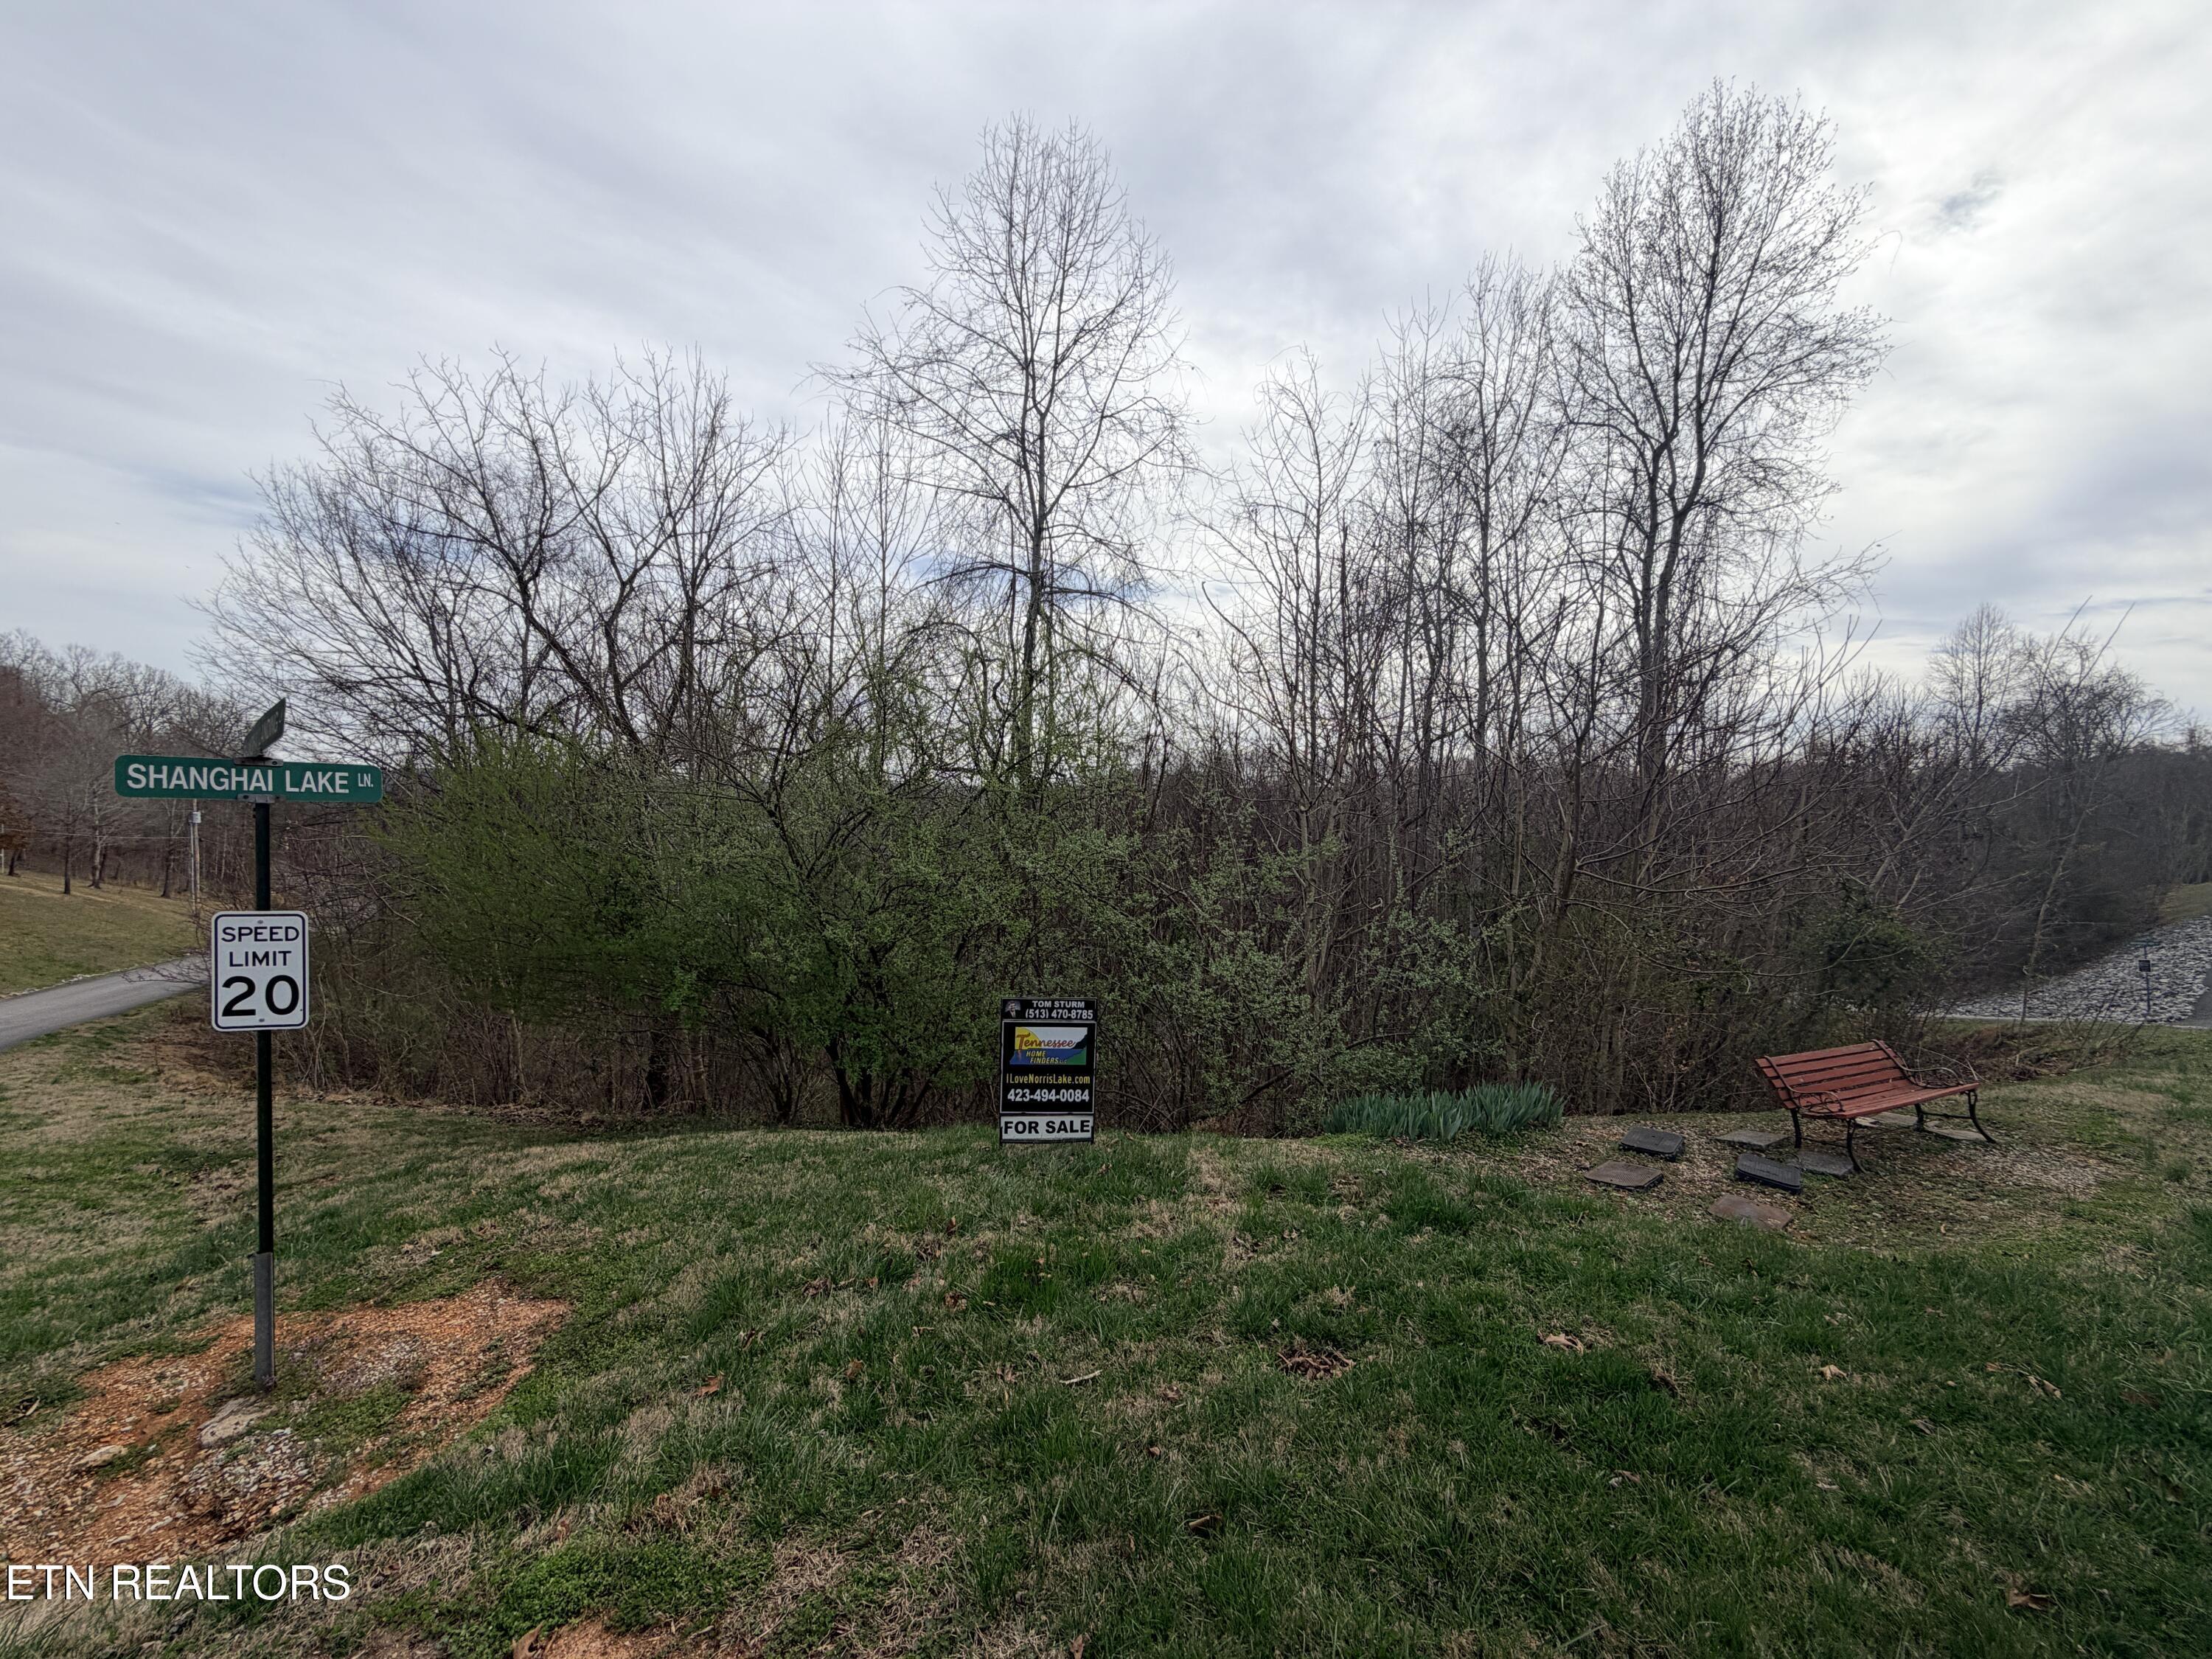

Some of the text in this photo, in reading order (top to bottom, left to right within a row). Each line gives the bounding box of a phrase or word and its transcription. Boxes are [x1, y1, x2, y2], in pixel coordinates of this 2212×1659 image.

[127, 763, 374, 793] SHANGHAI LAKE LN.
[221, 926, 299, 942] SPEED
[229, 950, 292, 967] LIMIT
[221, 975, 299, 1017] 20
[1032, 1000, 1052, 1008] TOM
[1025, 1009, 1093, 1019] (513) 470-8785
[1016, 1032, 1076, 1050] Tennessee
[1007, 1088, 1090, 1102] 423-494-0084
[1004, 1120, 1091, 1135] FOR SALE
